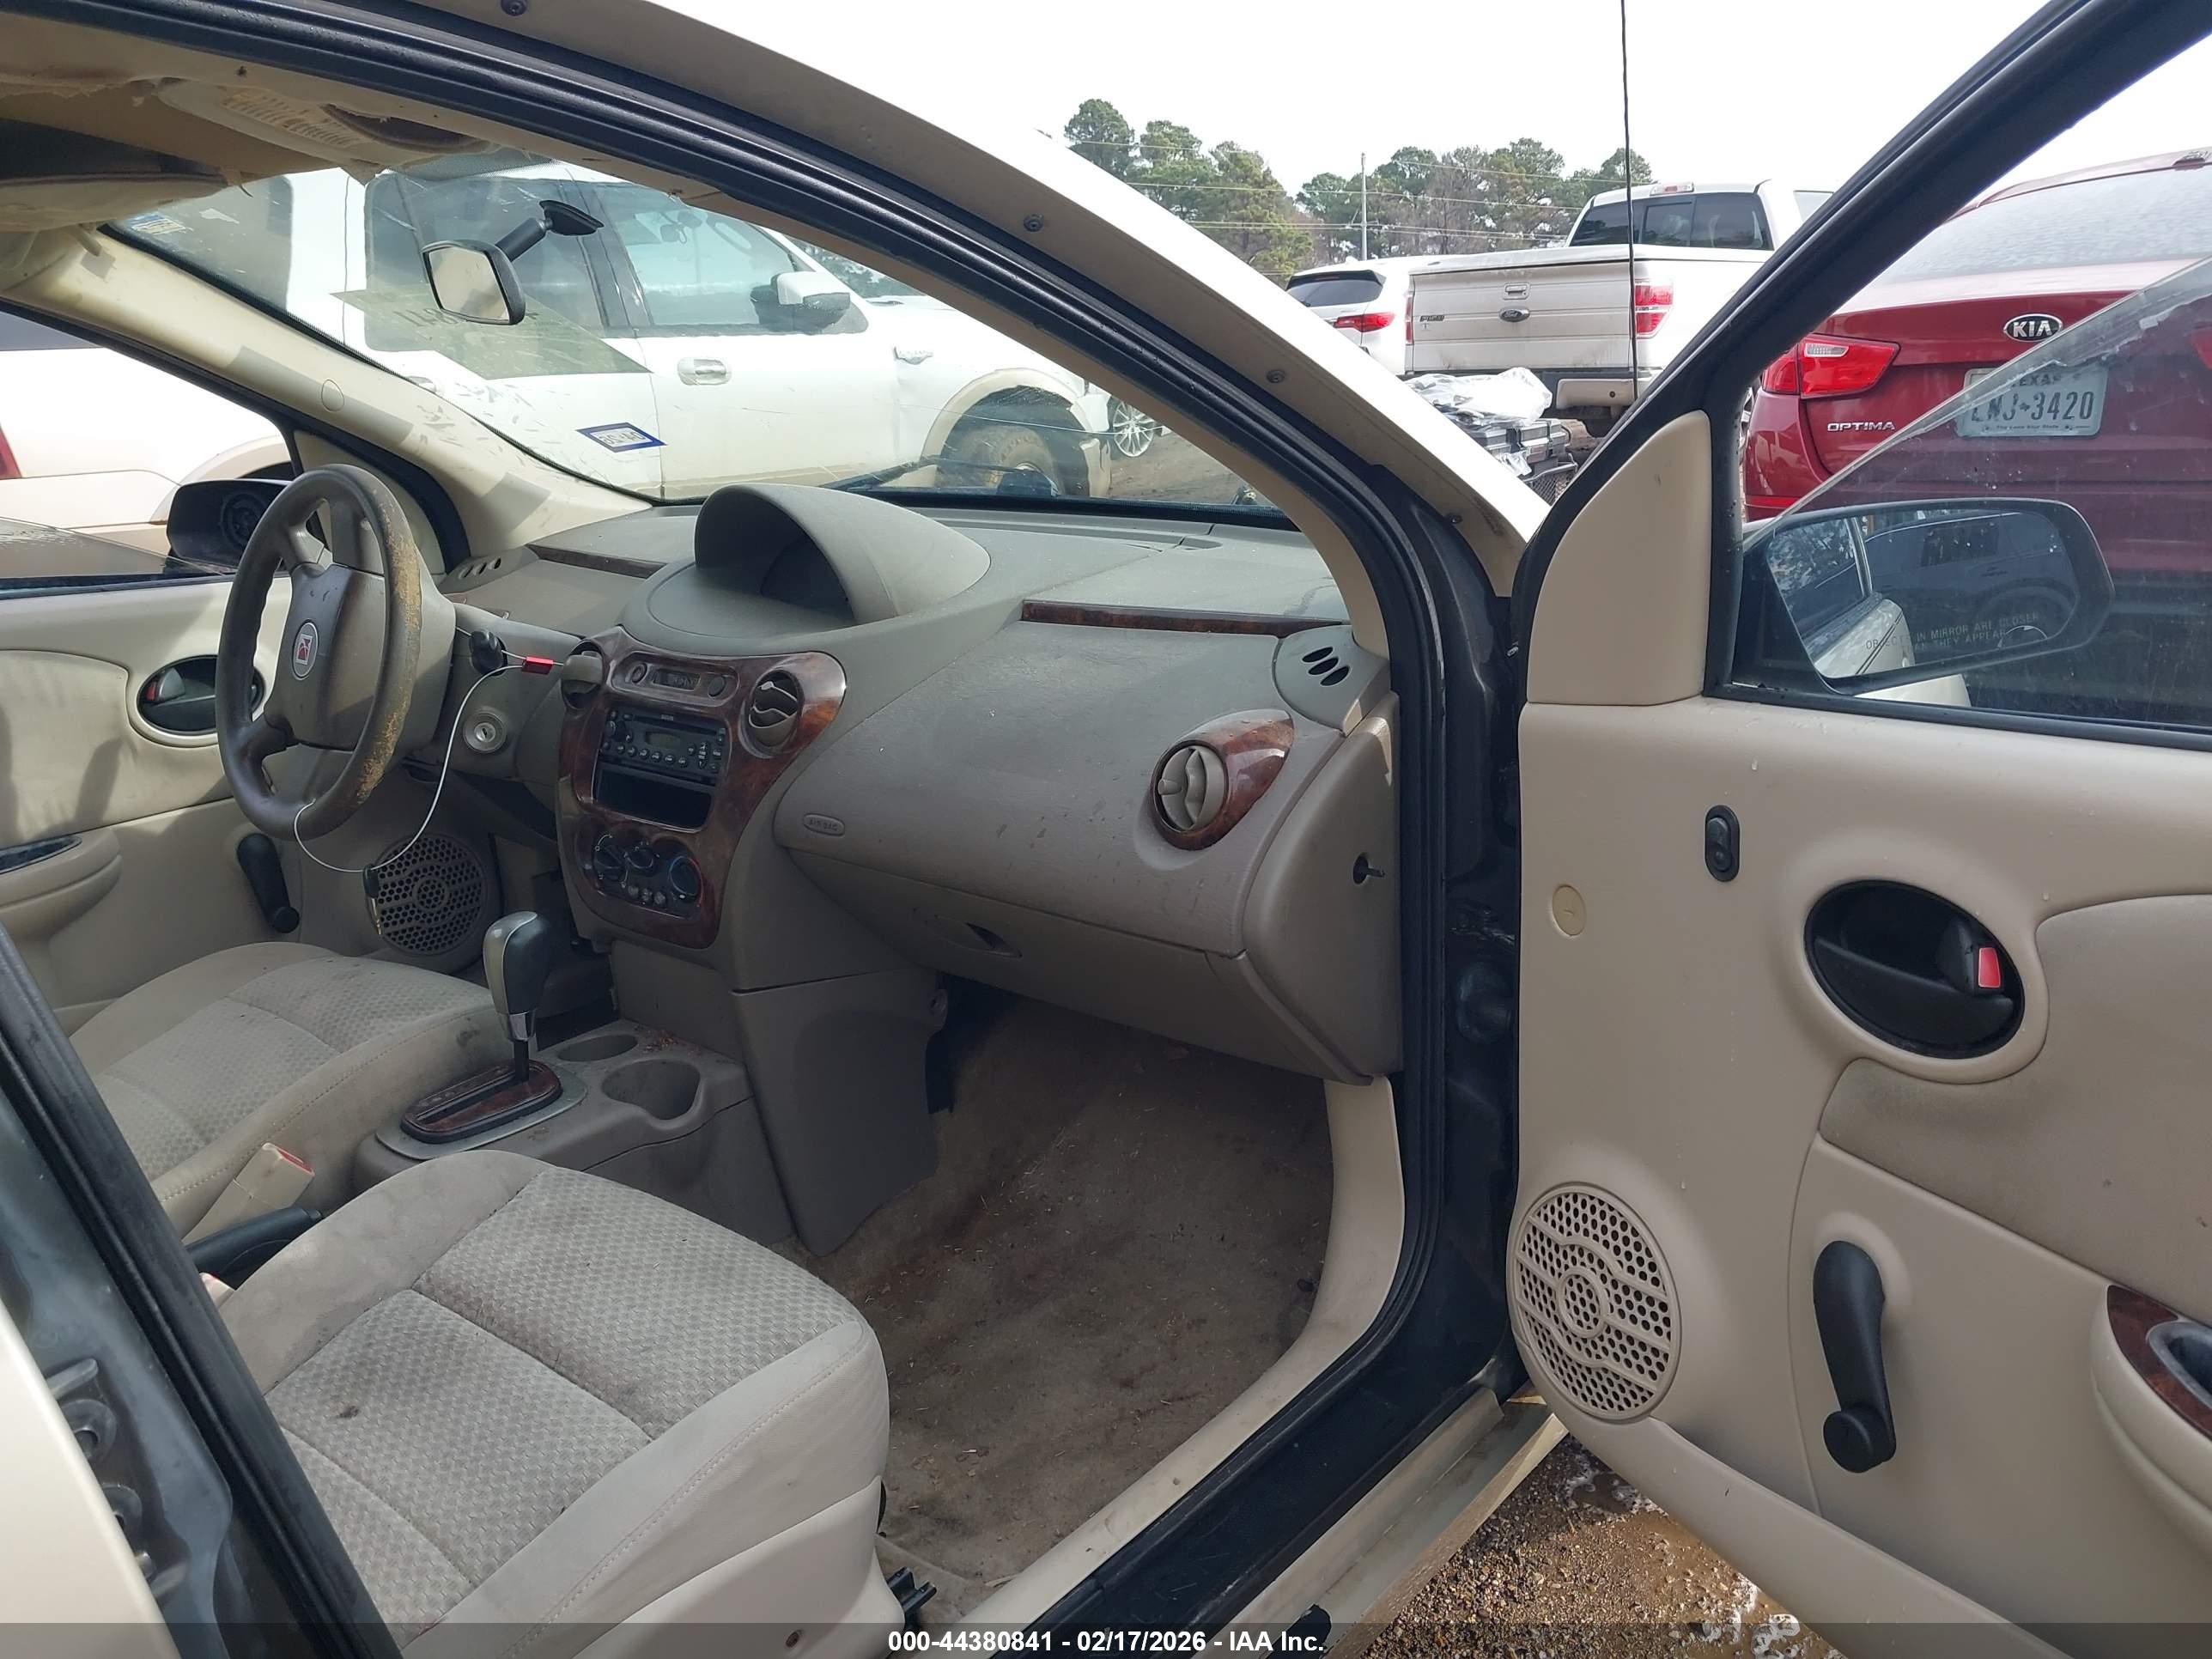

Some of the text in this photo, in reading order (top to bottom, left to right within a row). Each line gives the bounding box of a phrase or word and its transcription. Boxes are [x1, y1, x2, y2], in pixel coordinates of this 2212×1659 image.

[2013, 319, 2052, 337] KIA
[1827, 421, 1896, 432] OPTIMA
[1930, 624, 1968, 639] MIRROR
